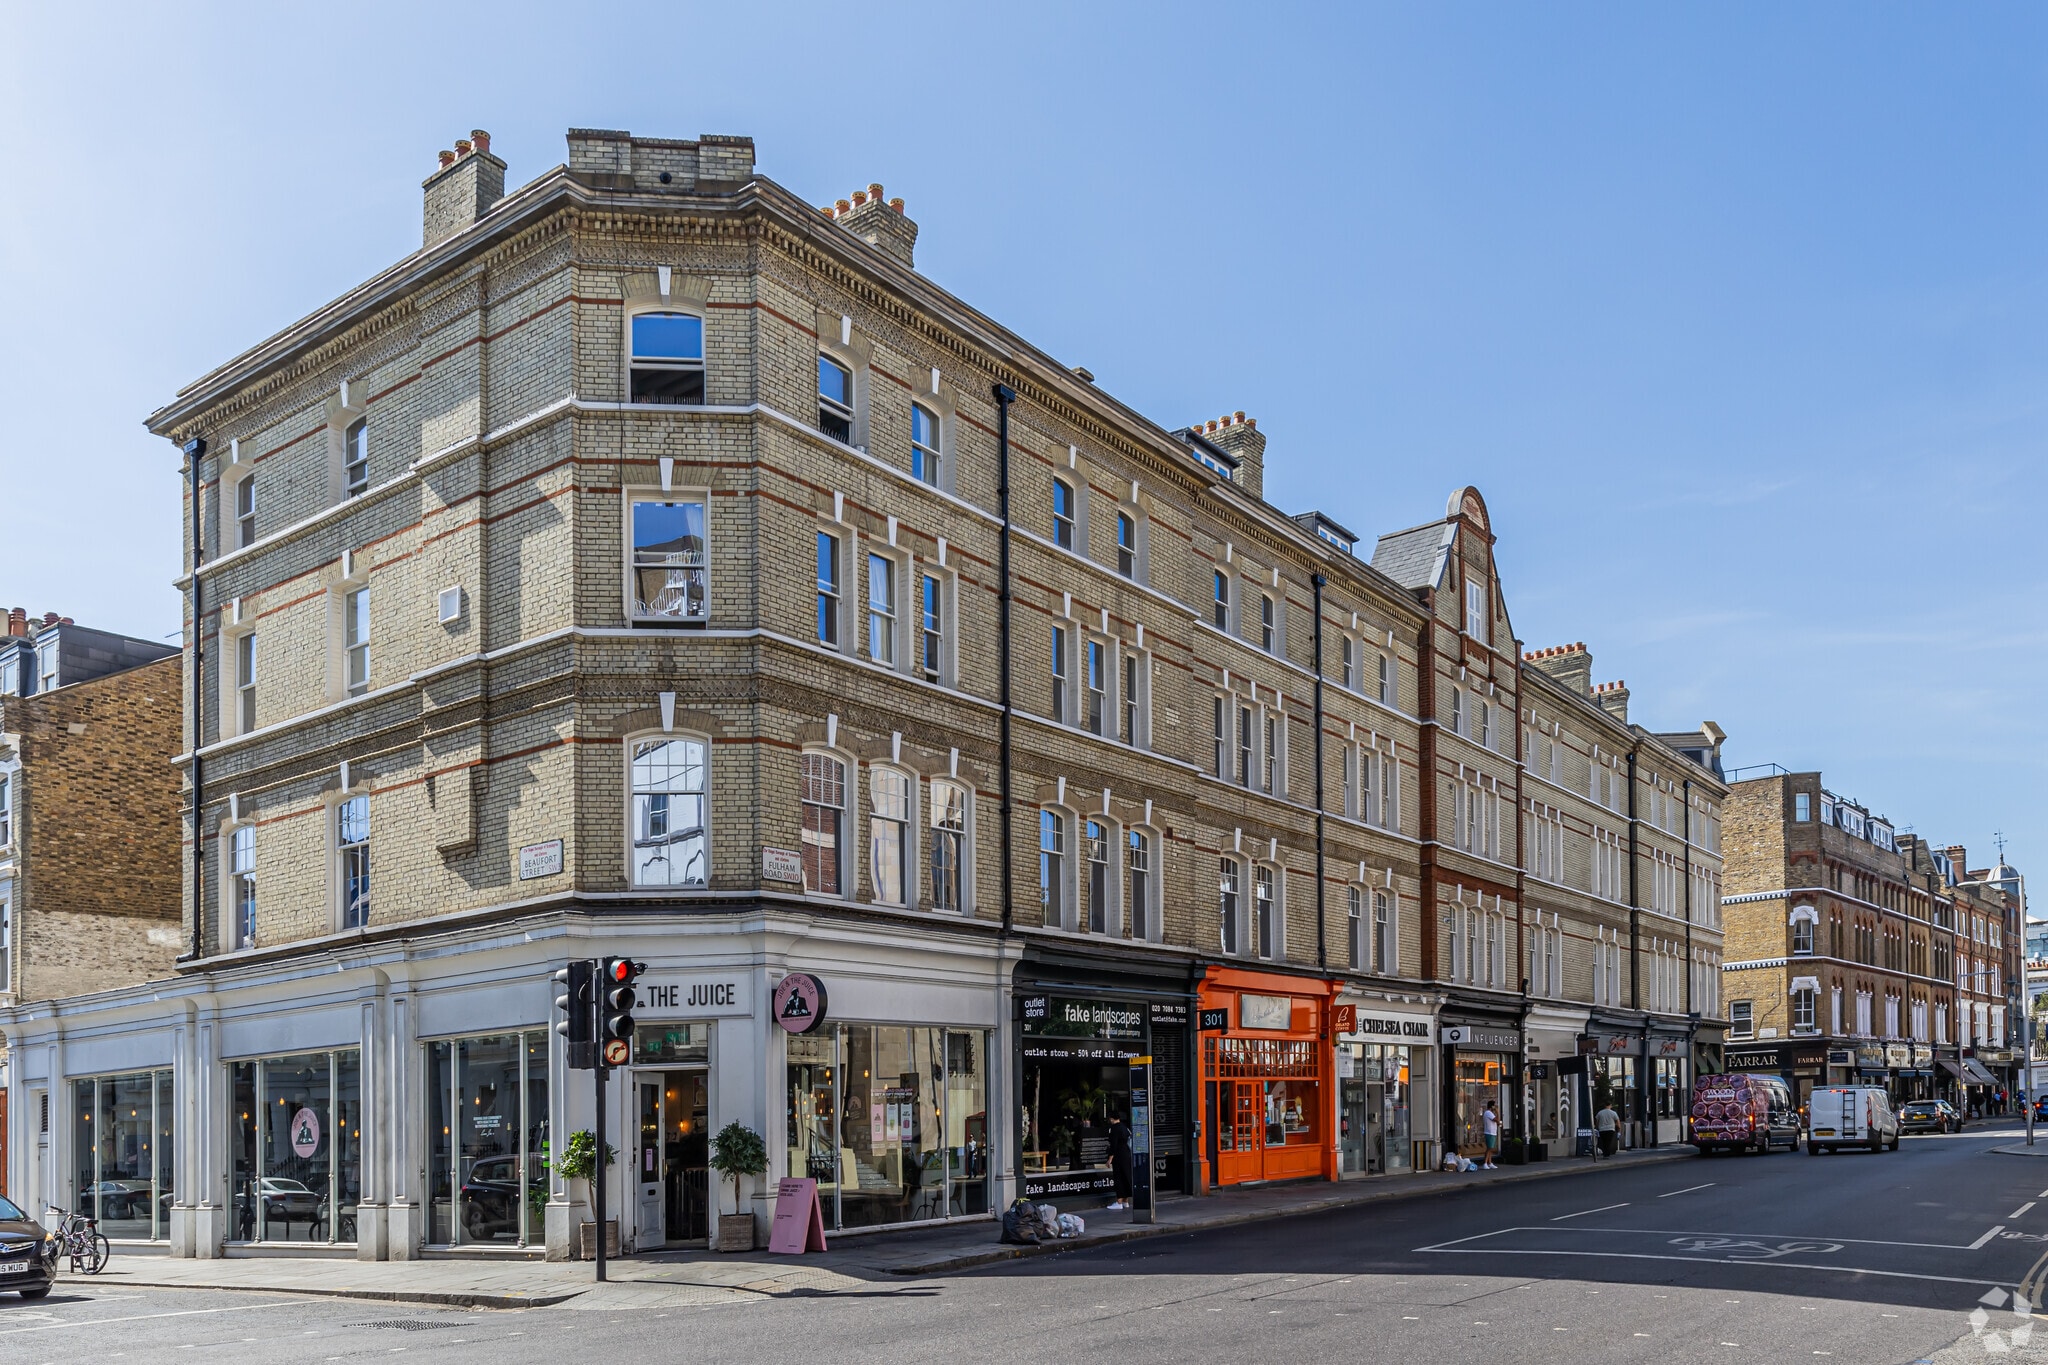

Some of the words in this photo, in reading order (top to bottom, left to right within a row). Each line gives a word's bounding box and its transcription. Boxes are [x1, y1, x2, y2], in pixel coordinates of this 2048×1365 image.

[524, 854, 557, 868] BEAUFORT
[768, 861, 796, 872] FULHAM
[521, 865, 545, 878] STREET
[548, 862, 562, 872] SW3
[764, 869, 783, 879] ROAD
[783, 871, 800, 881] SW10
[777, 985, 786, 998] JOE
[790, 976, 801, 985] THE
[801, 979, 815, 997] JUICE
[636, 1000, 646, 1008] &
[647, 985, 679, 1007] THE
[687, 983, 735, 1007] JUICE
[1024, 997, 1045, 1008] outlet
[1025, 1008, 1044, 1018] store
[1064, 1004, 1090, 1022] fake
[1092, 1005, 1141, 1029] landscapes
[1204, 1013, 1223, 1026] 301
[1362, 1018, 1402, 1035] CHELSEA
[1403, 1021, 1429, 1037] CHAIR
[1471, 1032, 1518, 1046] INFLUENCER
[1024, 1048, 1048, 1057] outlet
[1050, 1048, 1069, 1057] store
[1091, 1049, 1102, 1058] off
[1104, 1050, 1115, 1058] all
[1117, 1050, 1140, 1060] flowers
[1797, 1056, 1824, 1064] FARRAR
[1728, 1055, 1778, 1068] FARRAR
[1026, 1183, 1044, 1195] fake
[1047, 1181, 1090, 1193] landscapes
